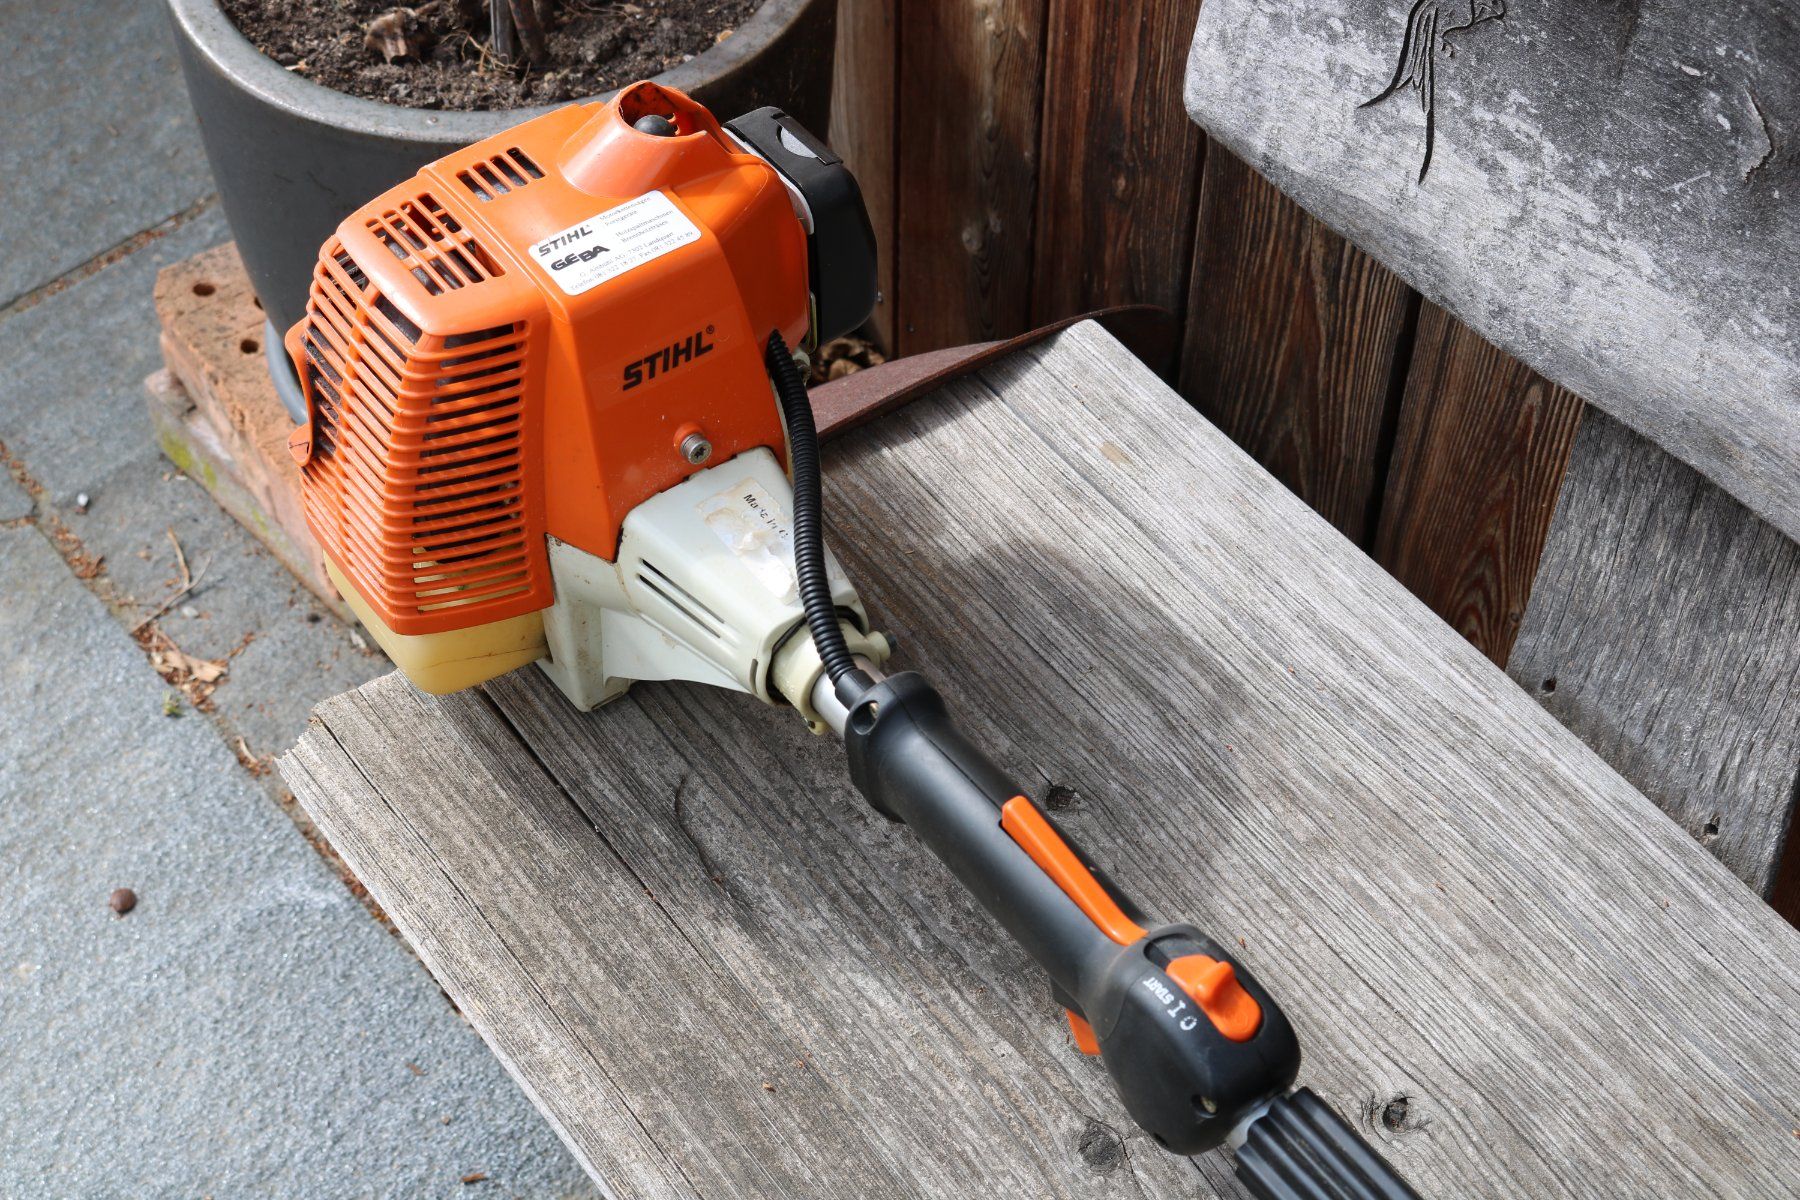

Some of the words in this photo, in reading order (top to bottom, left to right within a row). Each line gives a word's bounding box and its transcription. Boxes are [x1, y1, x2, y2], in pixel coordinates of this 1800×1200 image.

[538, 226, 593, 257] STIHL
[551, 245, 610, 271] GEBA
[622, 331, 714, 391] STIHL
[1142, 976, 1175, 1005] START
